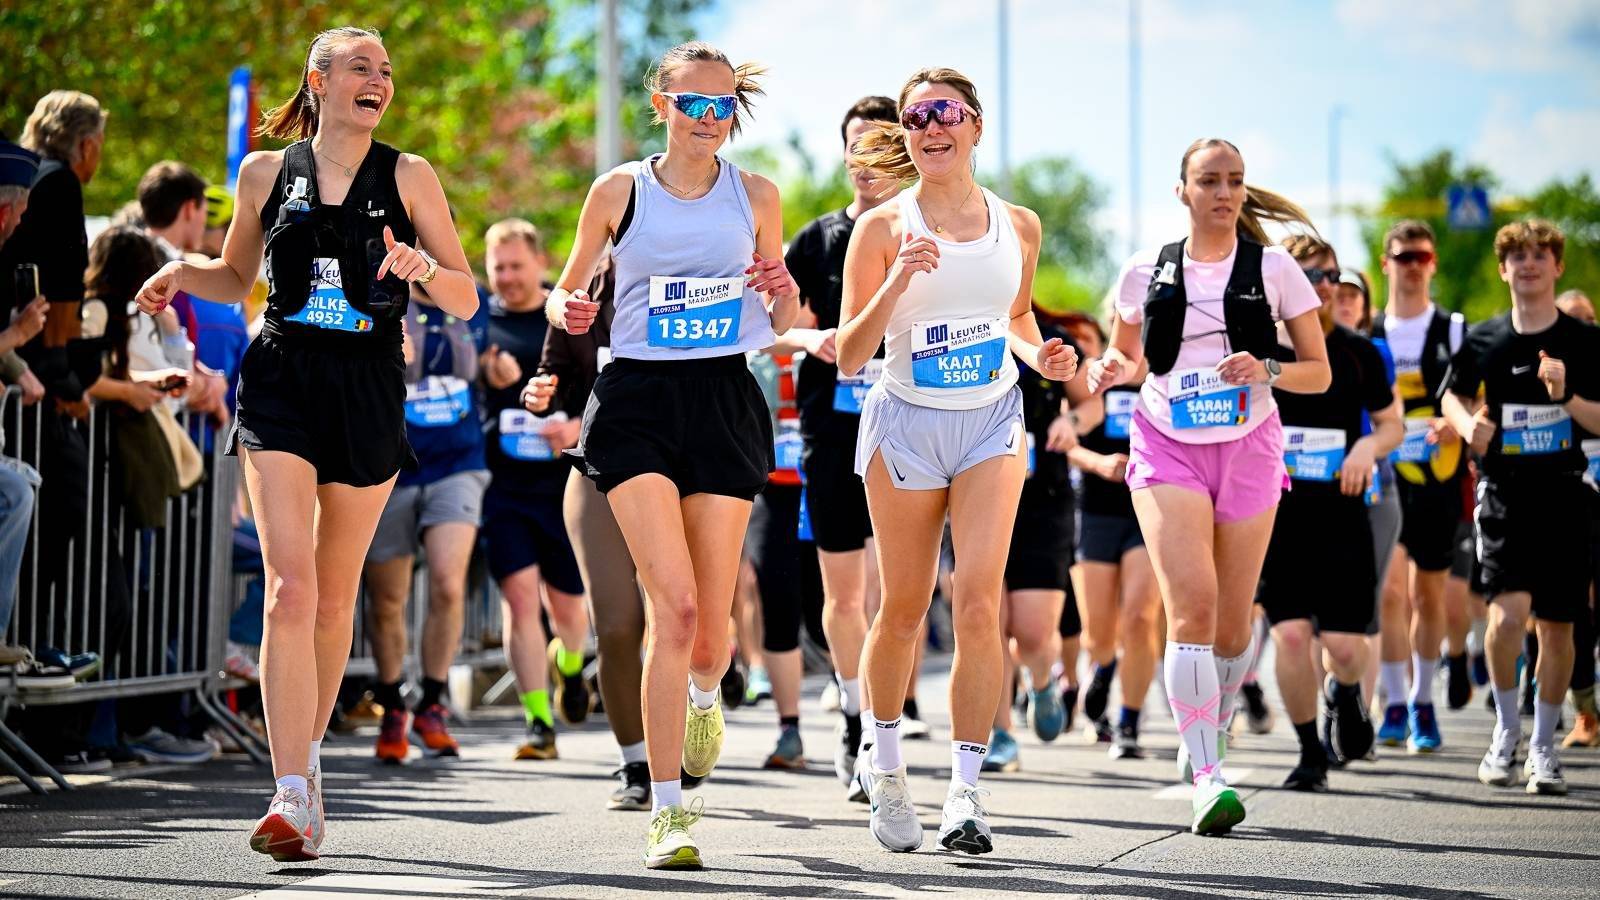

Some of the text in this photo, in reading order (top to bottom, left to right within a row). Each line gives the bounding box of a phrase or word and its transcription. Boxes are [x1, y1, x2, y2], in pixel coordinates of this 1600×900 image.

[688, 283, 729, 298] LEUVEN
[307, 297, 347, 312] SILKE
[688, 292, 729, 305] MARATHON
[306, 310, 344, 324] 4952
[658, 318, 733, 339] 13347
[950, 322, 990, 340] LEUVEN
[951, 331, 991, 347] MARATHON
[938, 354, 982, 371] KAAT
[943, 369, 979, 383] 5506
[1187, 399, 1232, 412] SARAH
[1190, 411, 1230, 424] 12466
[960, 744, 987, 755] cep
